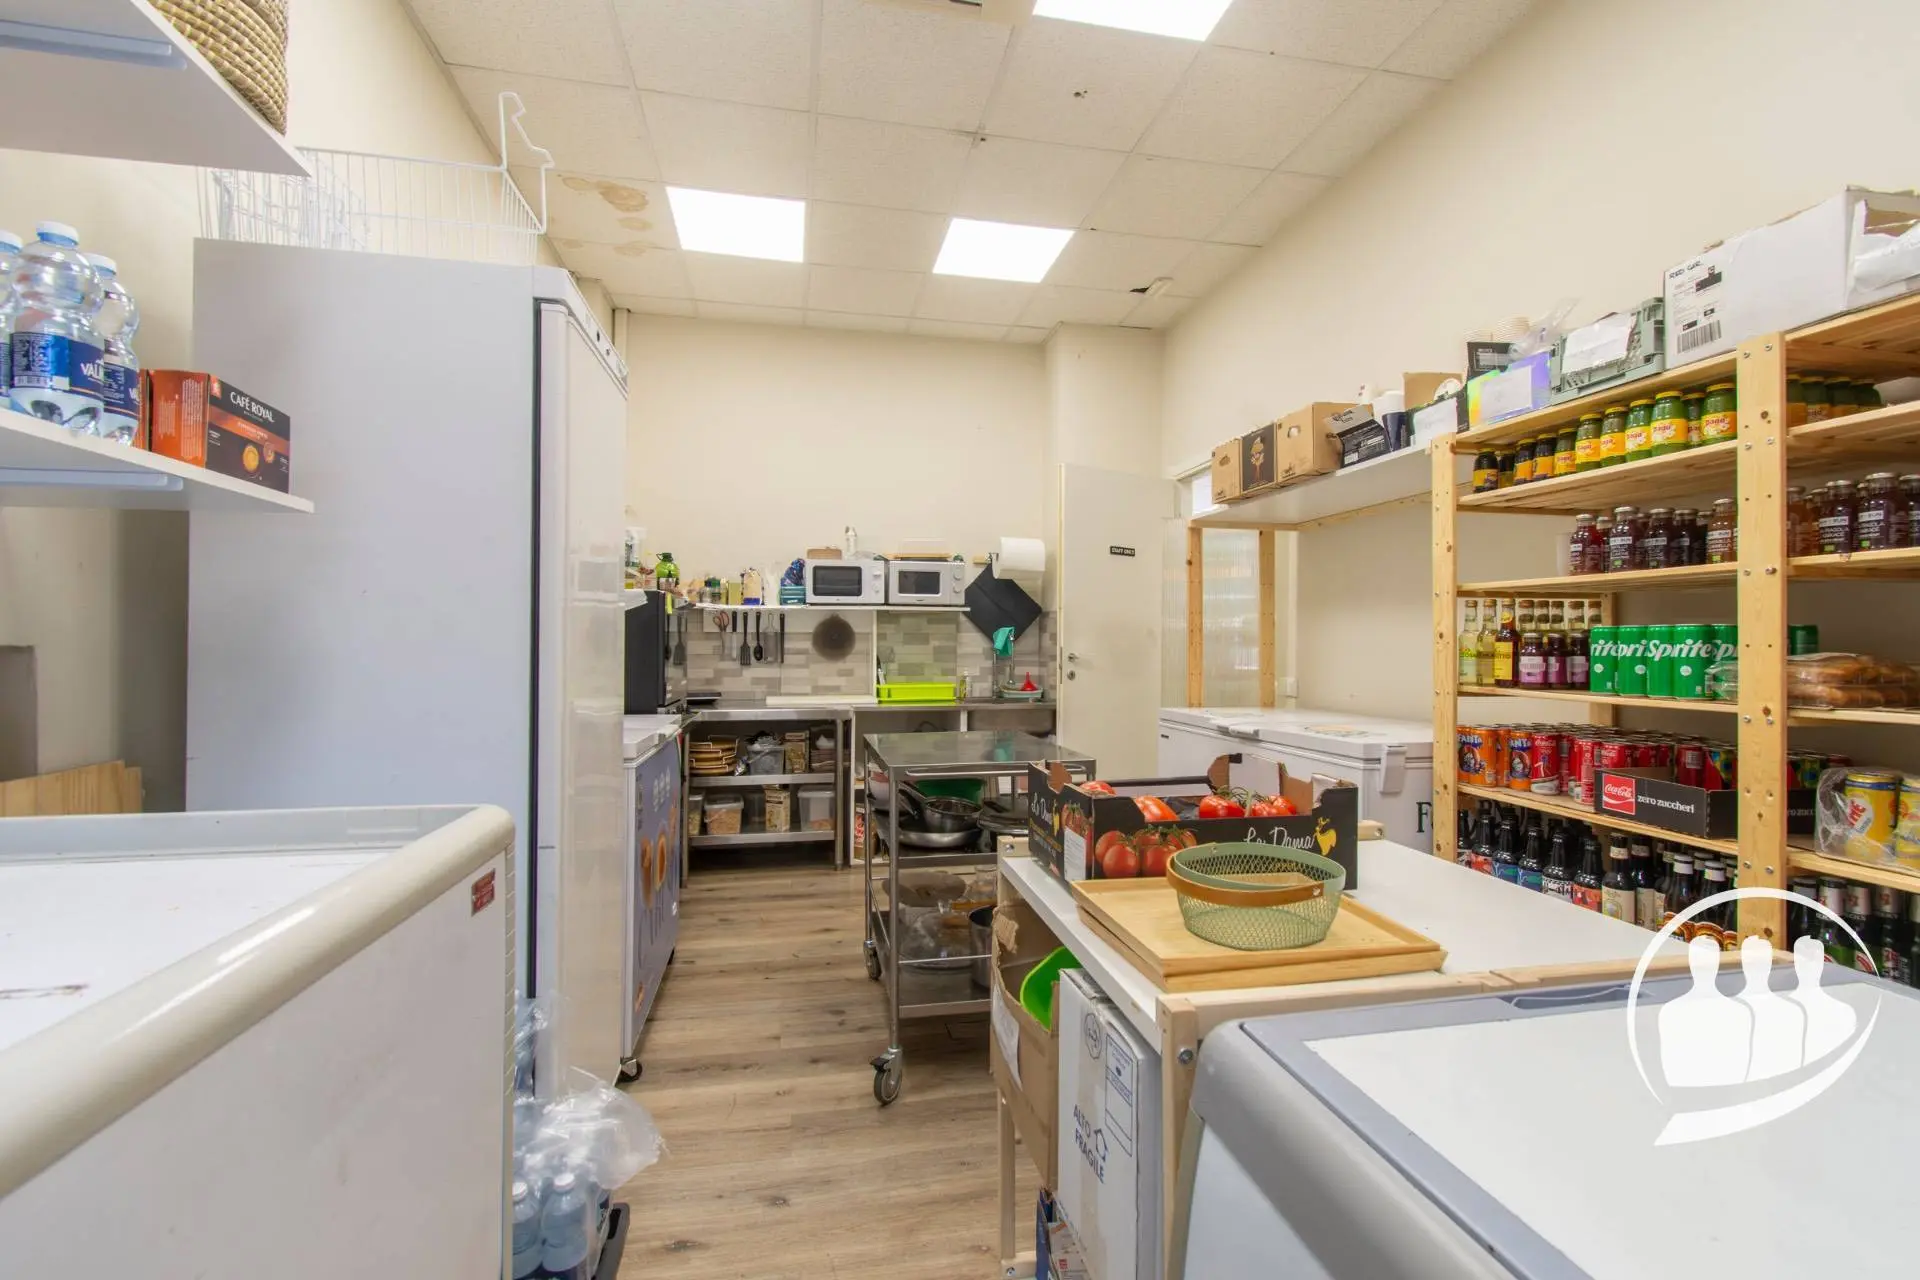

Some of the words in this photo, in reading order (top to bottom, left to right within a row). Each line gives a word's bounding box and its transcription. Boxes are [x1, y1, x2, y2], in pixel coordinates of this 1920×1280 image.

[230, 390, 250, 411] CAFÉ
[251, 401, 275, 423] ROYAL
[1637, 795, 1656, 806] zero
[1657, 798, 1695, 814] zuccheri
[1269, 826, 1315, 849] Dama
[1073, 1103, 1091, 1138] ALTO
[1075, 1127, 1105, 1184] FRAGILE
